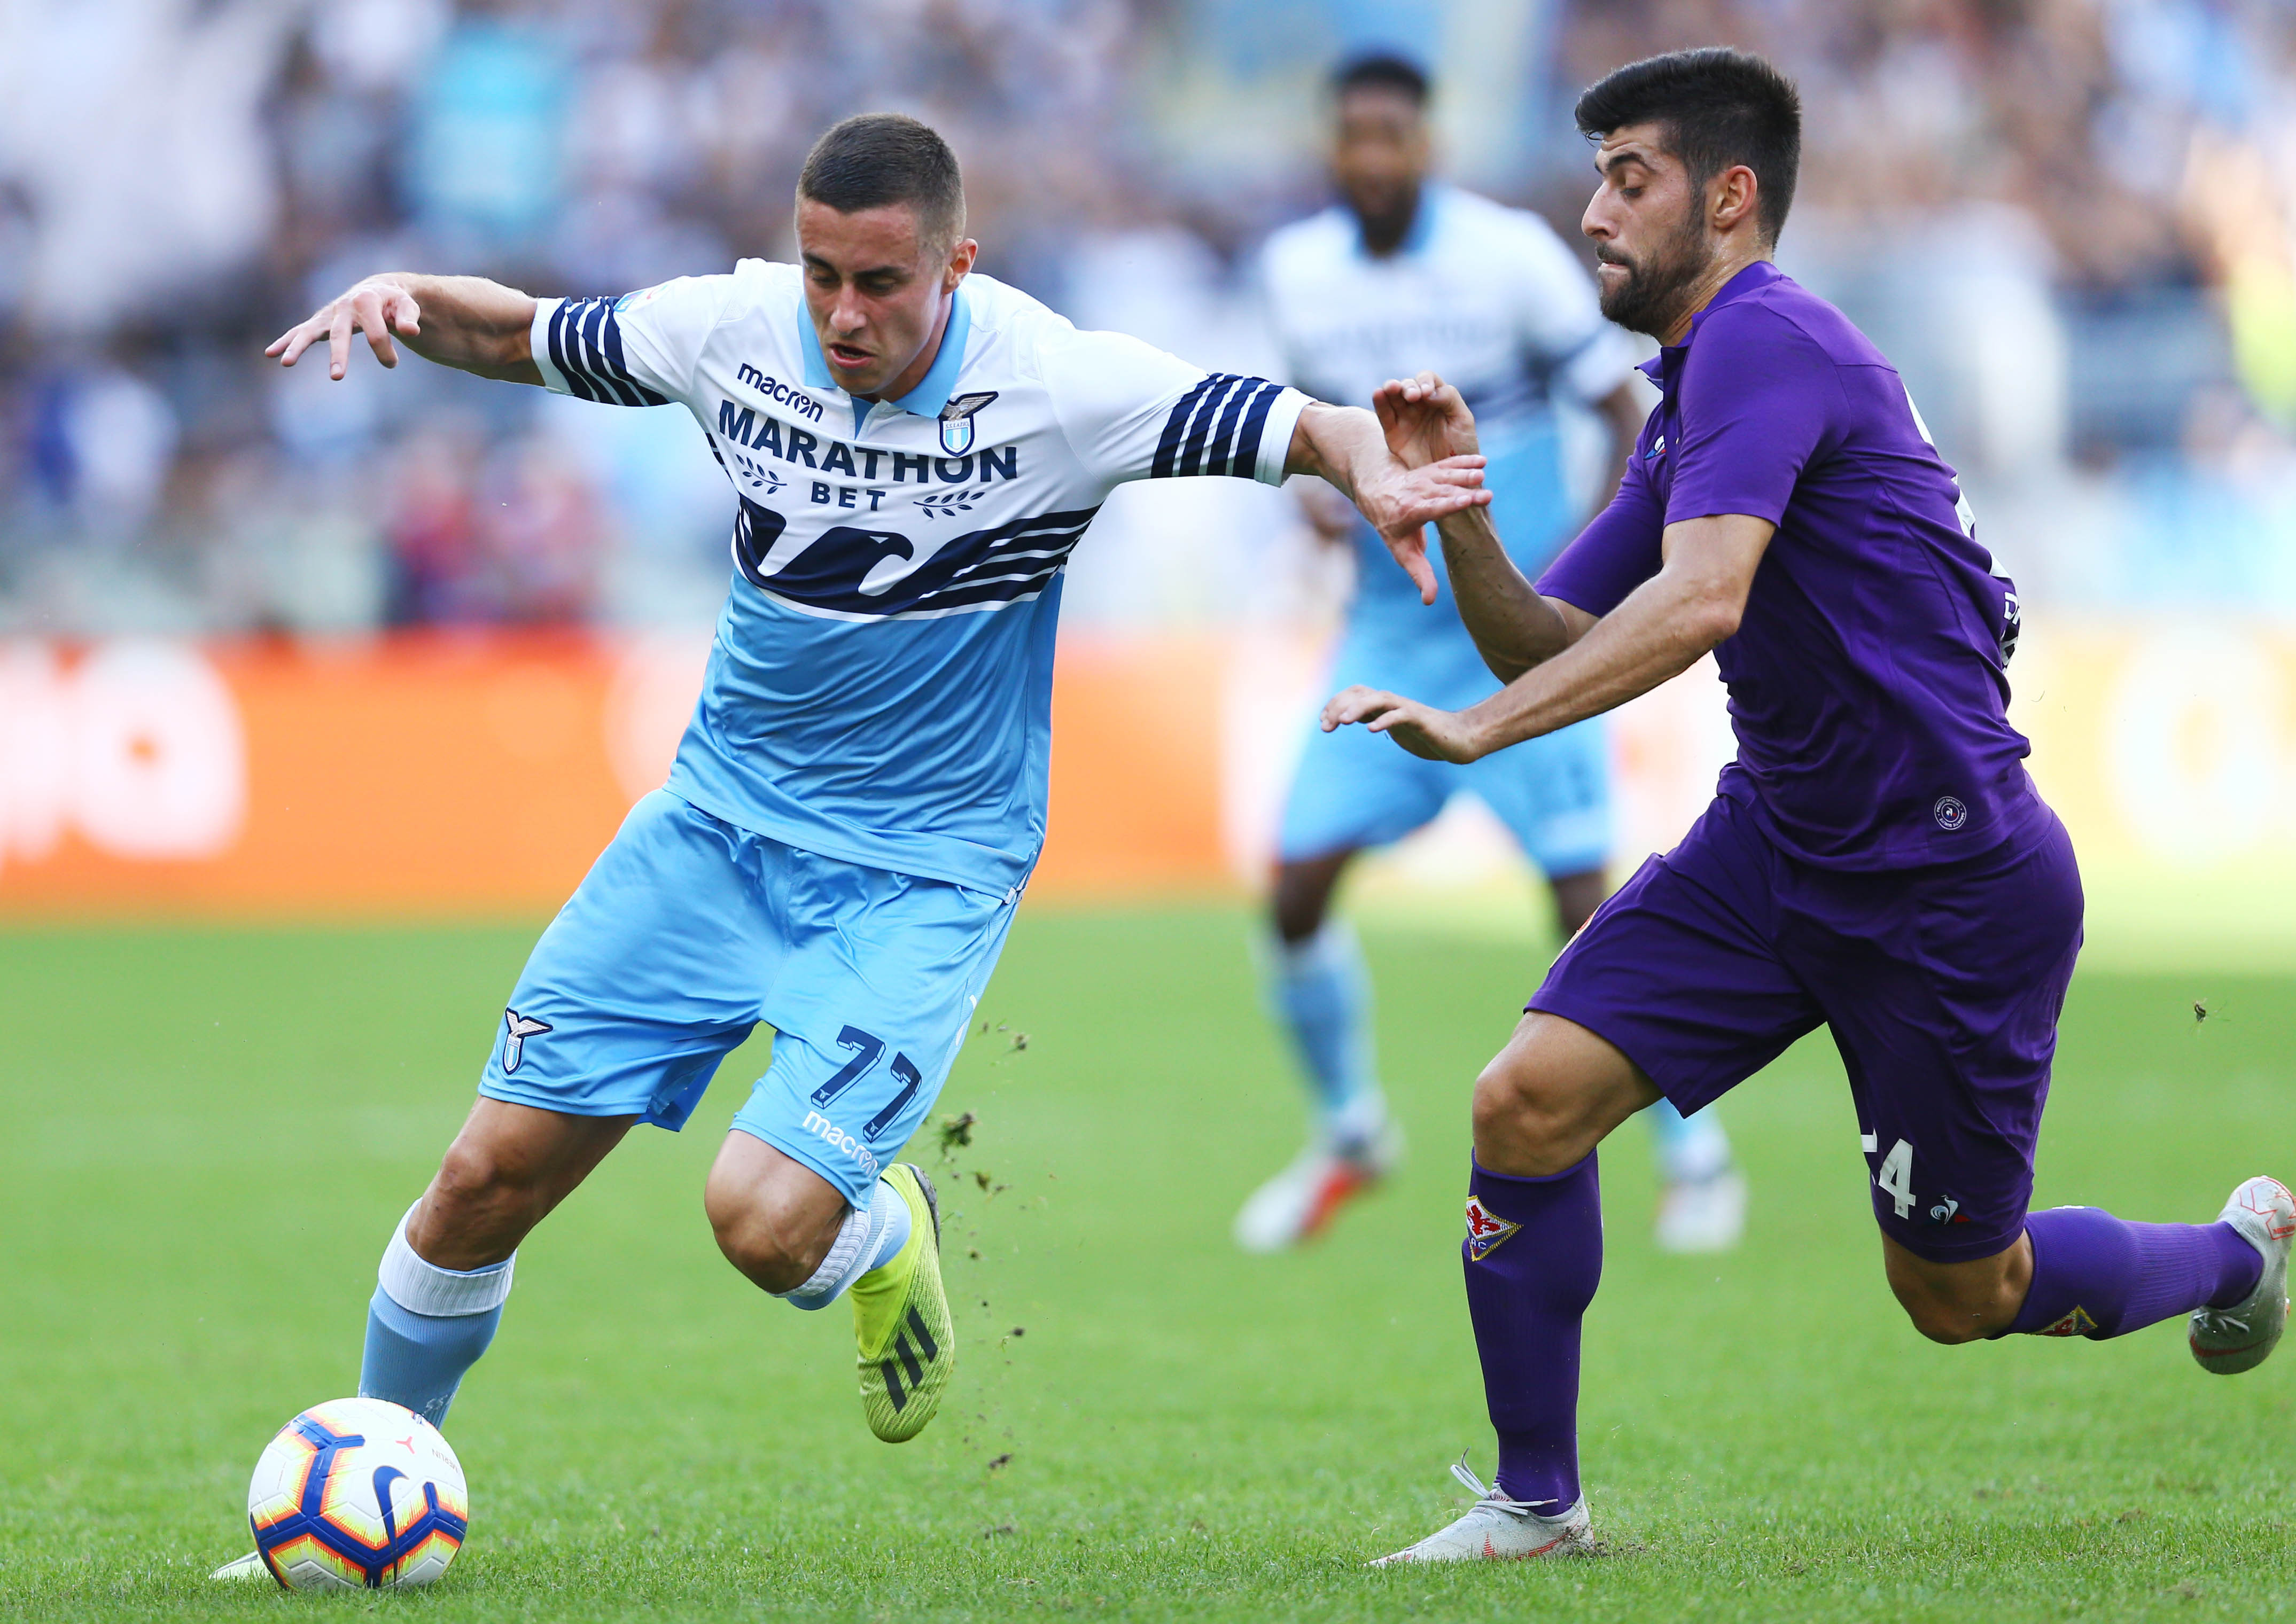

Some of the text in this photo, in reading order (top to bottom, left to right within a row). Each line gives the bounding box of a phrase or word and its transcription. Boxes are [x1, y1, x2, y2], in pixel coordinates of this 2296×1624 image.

[737, 363, 823, 423] macron
[719, 400, 1017, 483] MARATHON
[812, 481, 886, 512] BET
[811, 1025, 922, 1144] 77
[803, 1111, 878, 1178] macron
[1861, 1128, 1916, 1220] 4
[432, 1448, 457, 1473] MERLIN
